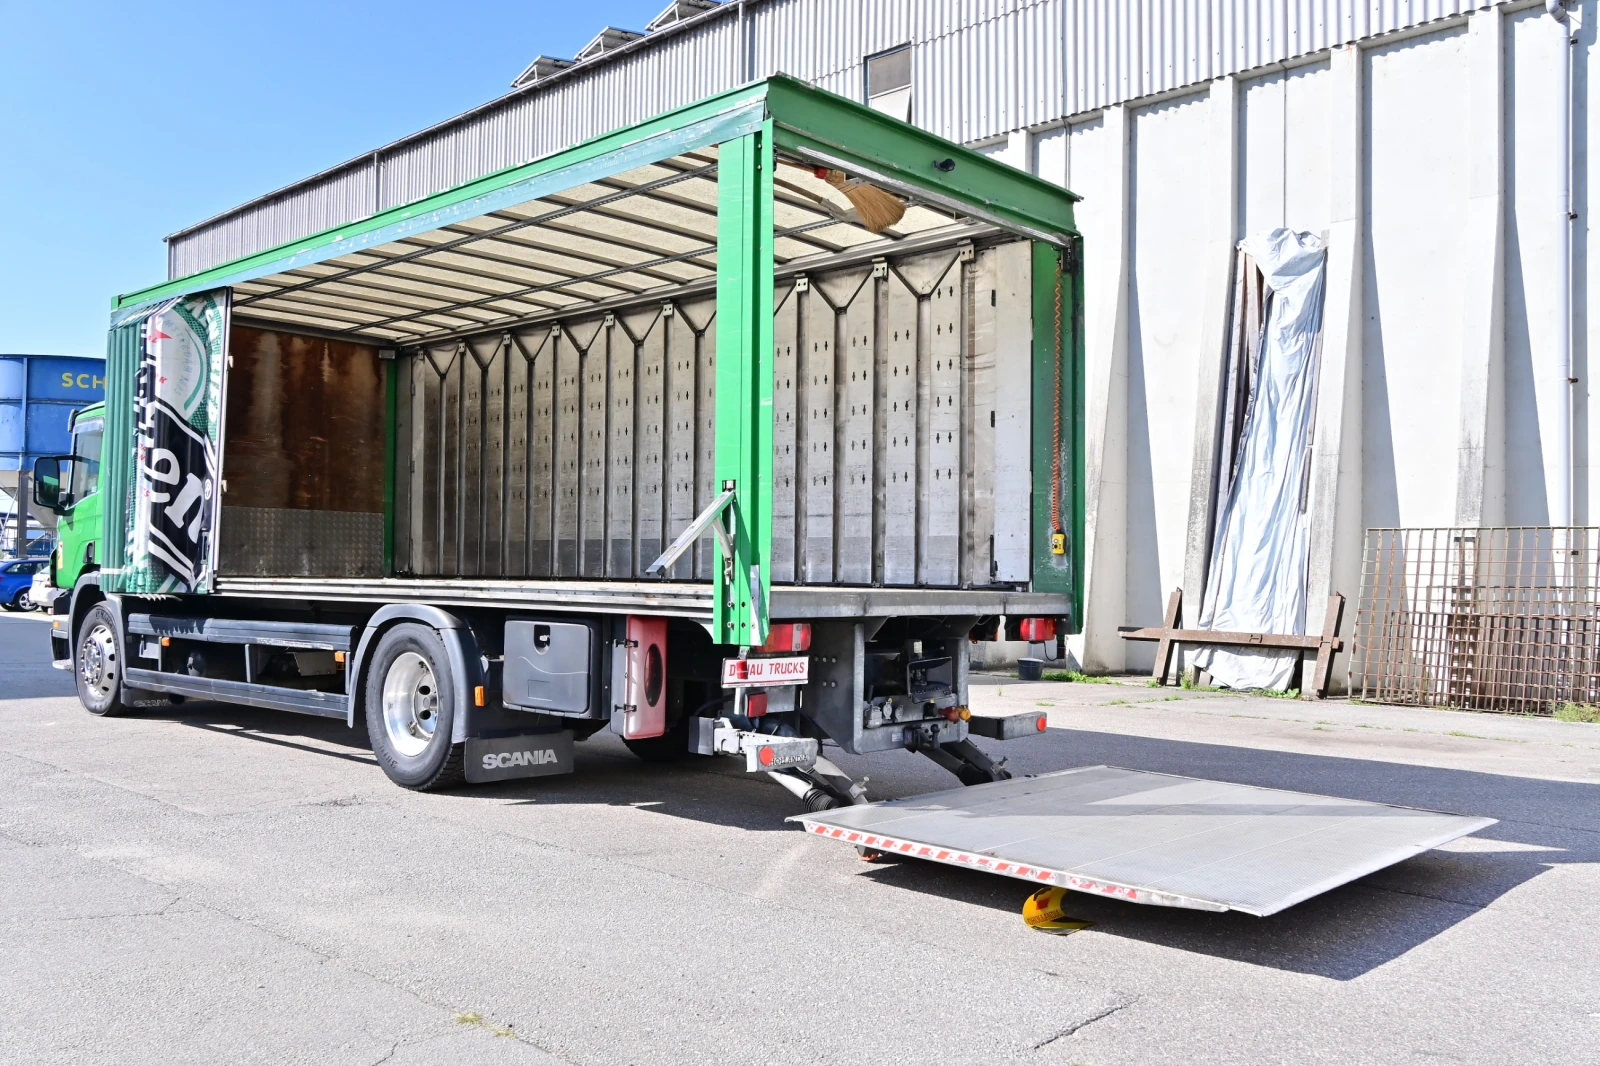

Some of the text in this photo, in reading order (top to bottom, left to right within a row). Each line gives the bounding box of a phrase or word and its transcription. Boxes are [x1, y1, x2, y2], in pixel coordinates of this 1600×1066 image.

[729, 661, 805, 677] DAU TRUCKS
[482, 748, 559, 770] SCANIA
